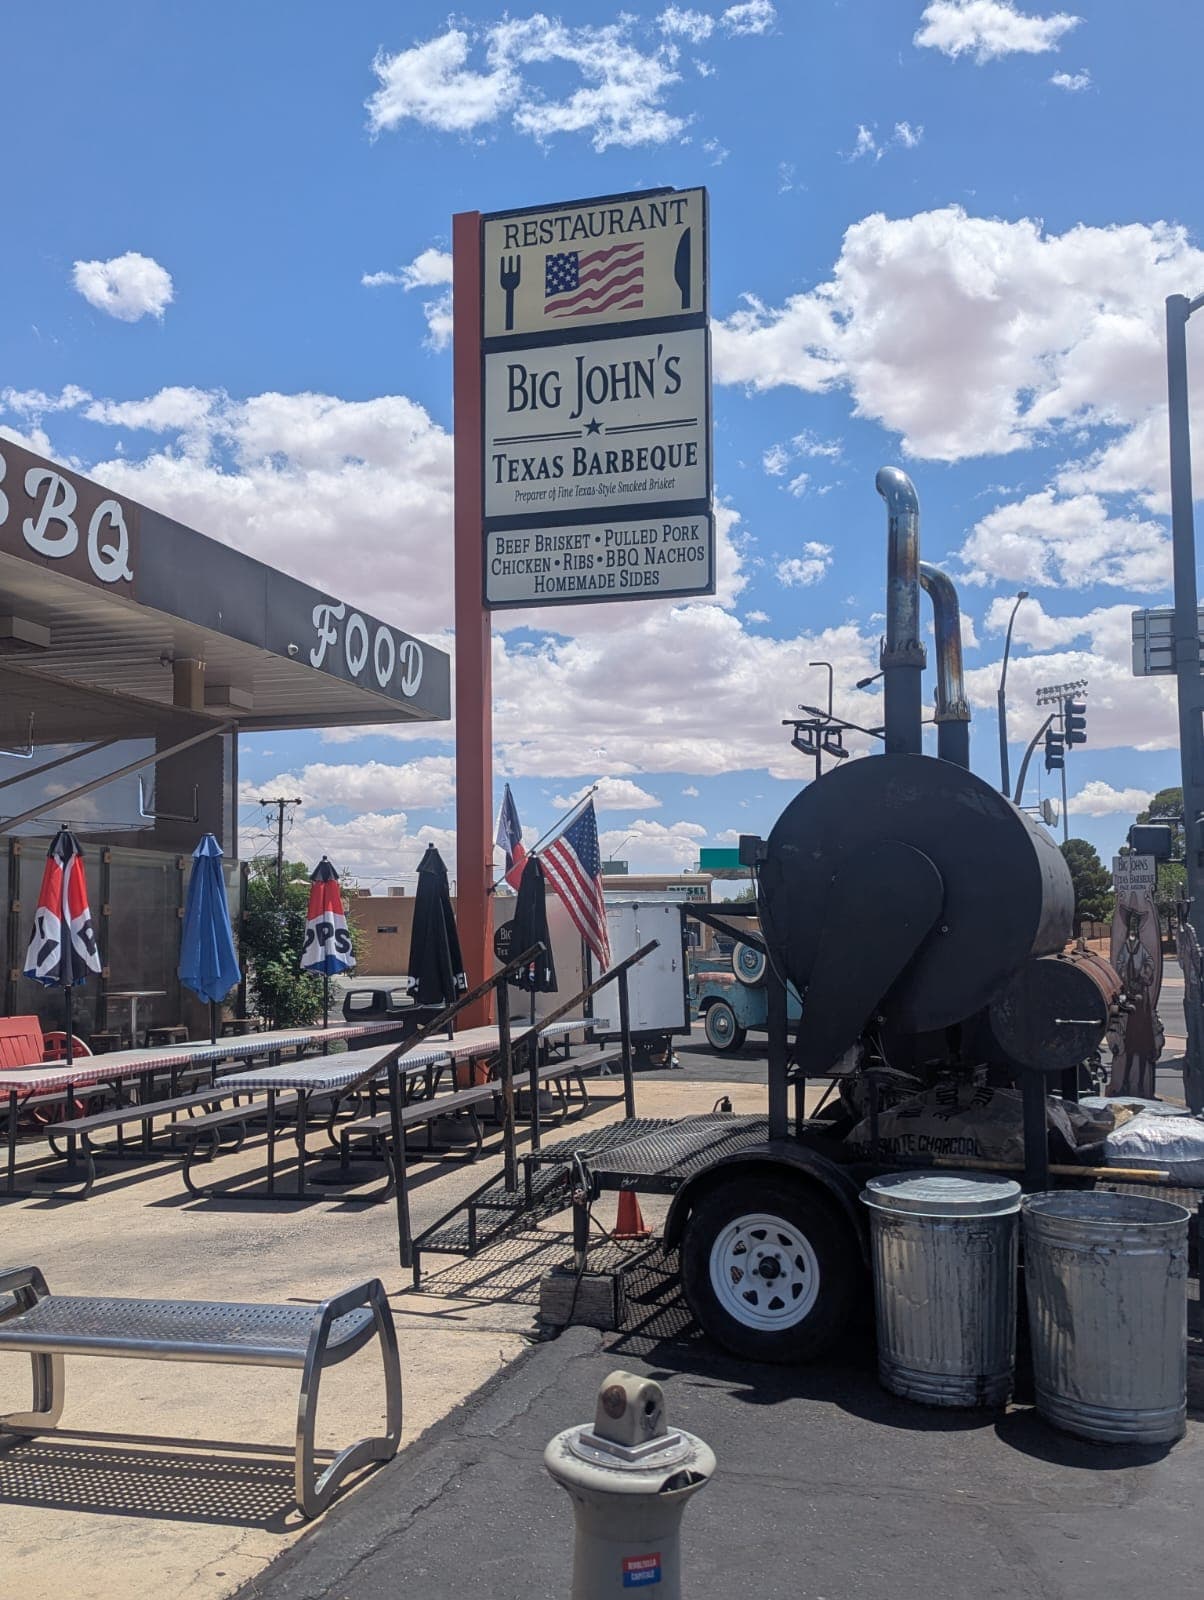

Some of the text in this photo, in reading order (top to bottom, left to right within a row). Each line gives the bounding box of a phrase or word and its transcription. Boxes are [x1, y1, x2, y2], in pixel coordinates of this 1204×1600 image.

[503, 199, 688, 249] RESTAURANT
[506, 344, 681, 419] BIG JOHN'S
[493, 442, 698, 483] TEXAS BARBEQUE
[515, 477, 676, 503] Preparer of Fine Texas-Style Smoked Brisket
[0, 453, 133, 583] BQ
[496, 524, 699, 555] BEEF BRISKET PULLED PORK
[491, 546, 705, 576] CHICKEN RIBS BBQ NACHOS
[534, 570, 660, 593] HOMEMADE SIDES
[310, 602, 423, 698] FOOD
[918, 1135, 981, 1157] CHARCOAL
